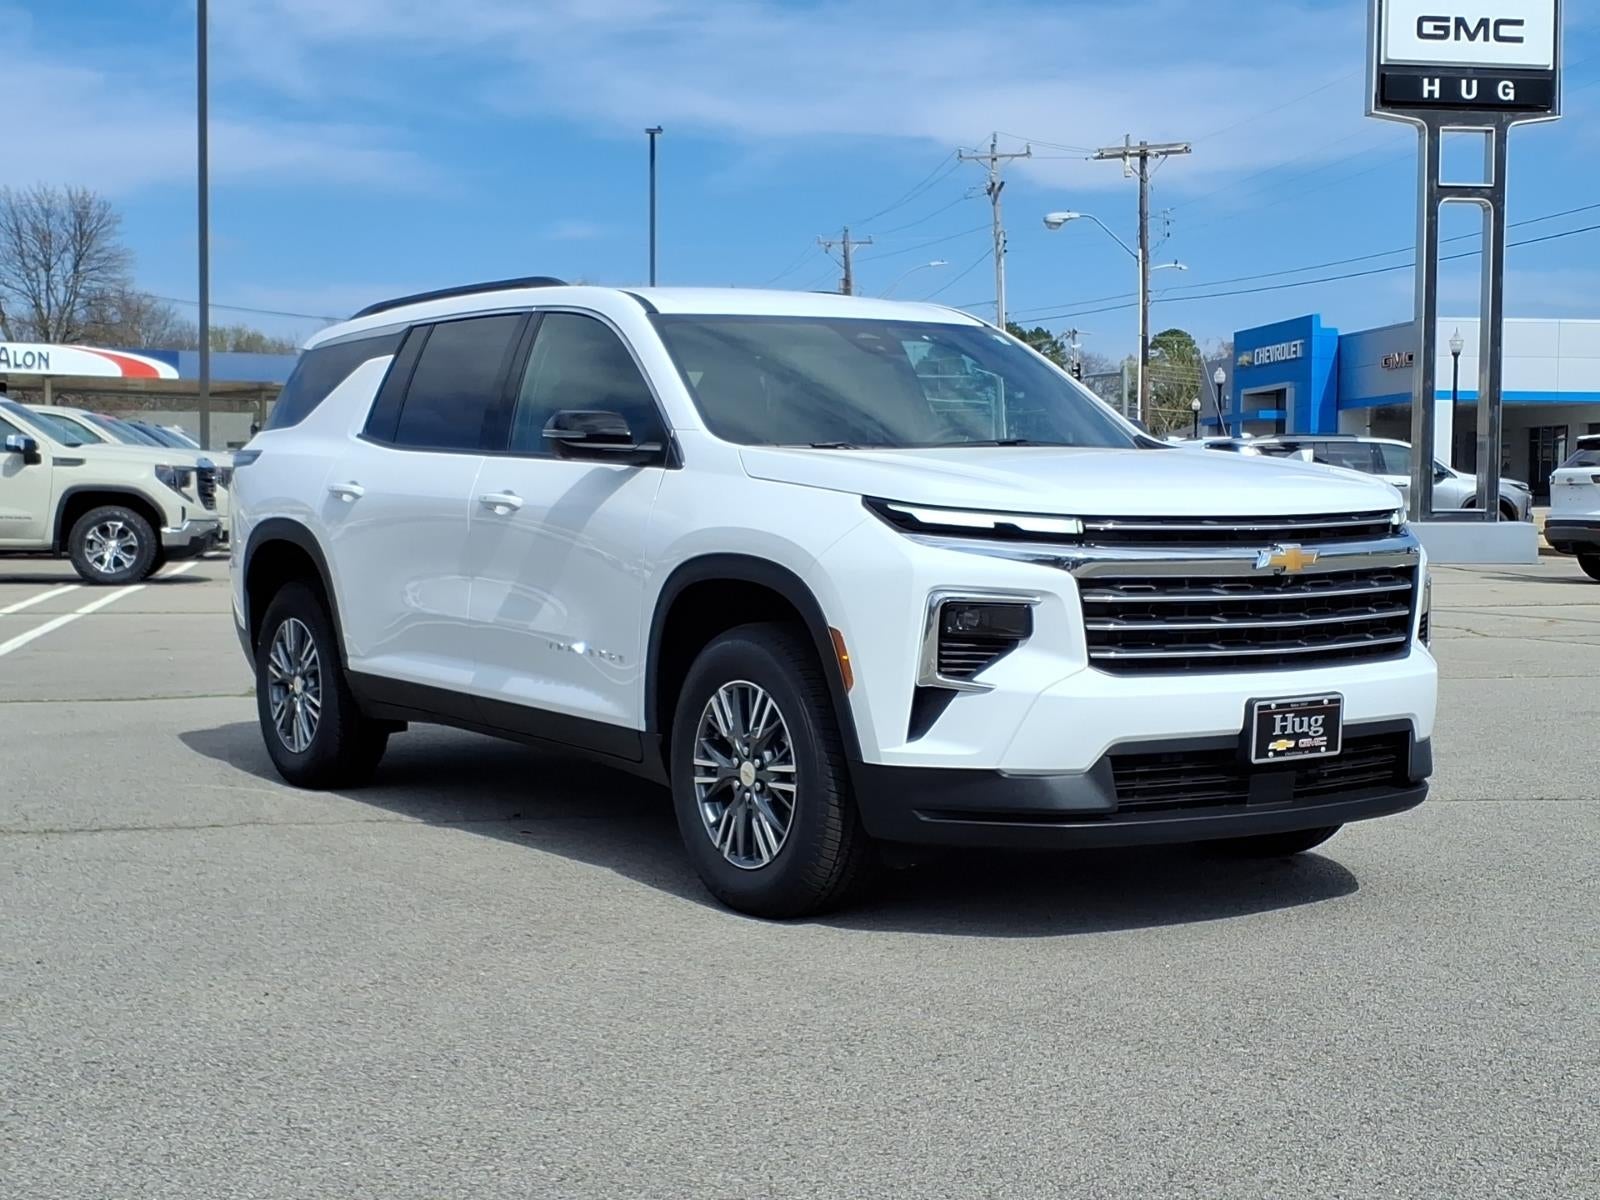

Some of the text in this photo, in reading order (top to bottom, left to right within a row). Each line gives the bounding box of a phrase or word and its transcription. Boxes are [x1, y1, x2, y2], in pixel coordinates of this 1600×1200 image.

[1416, 15, 1525, 44] GMC
[1422, 78, 1516, 101] HUG
[1254, 340, 1305, 366] CHEVROLET
[1381, 352, 1414, 369] GMC
[1272, 713, 1326, 737] Hug
